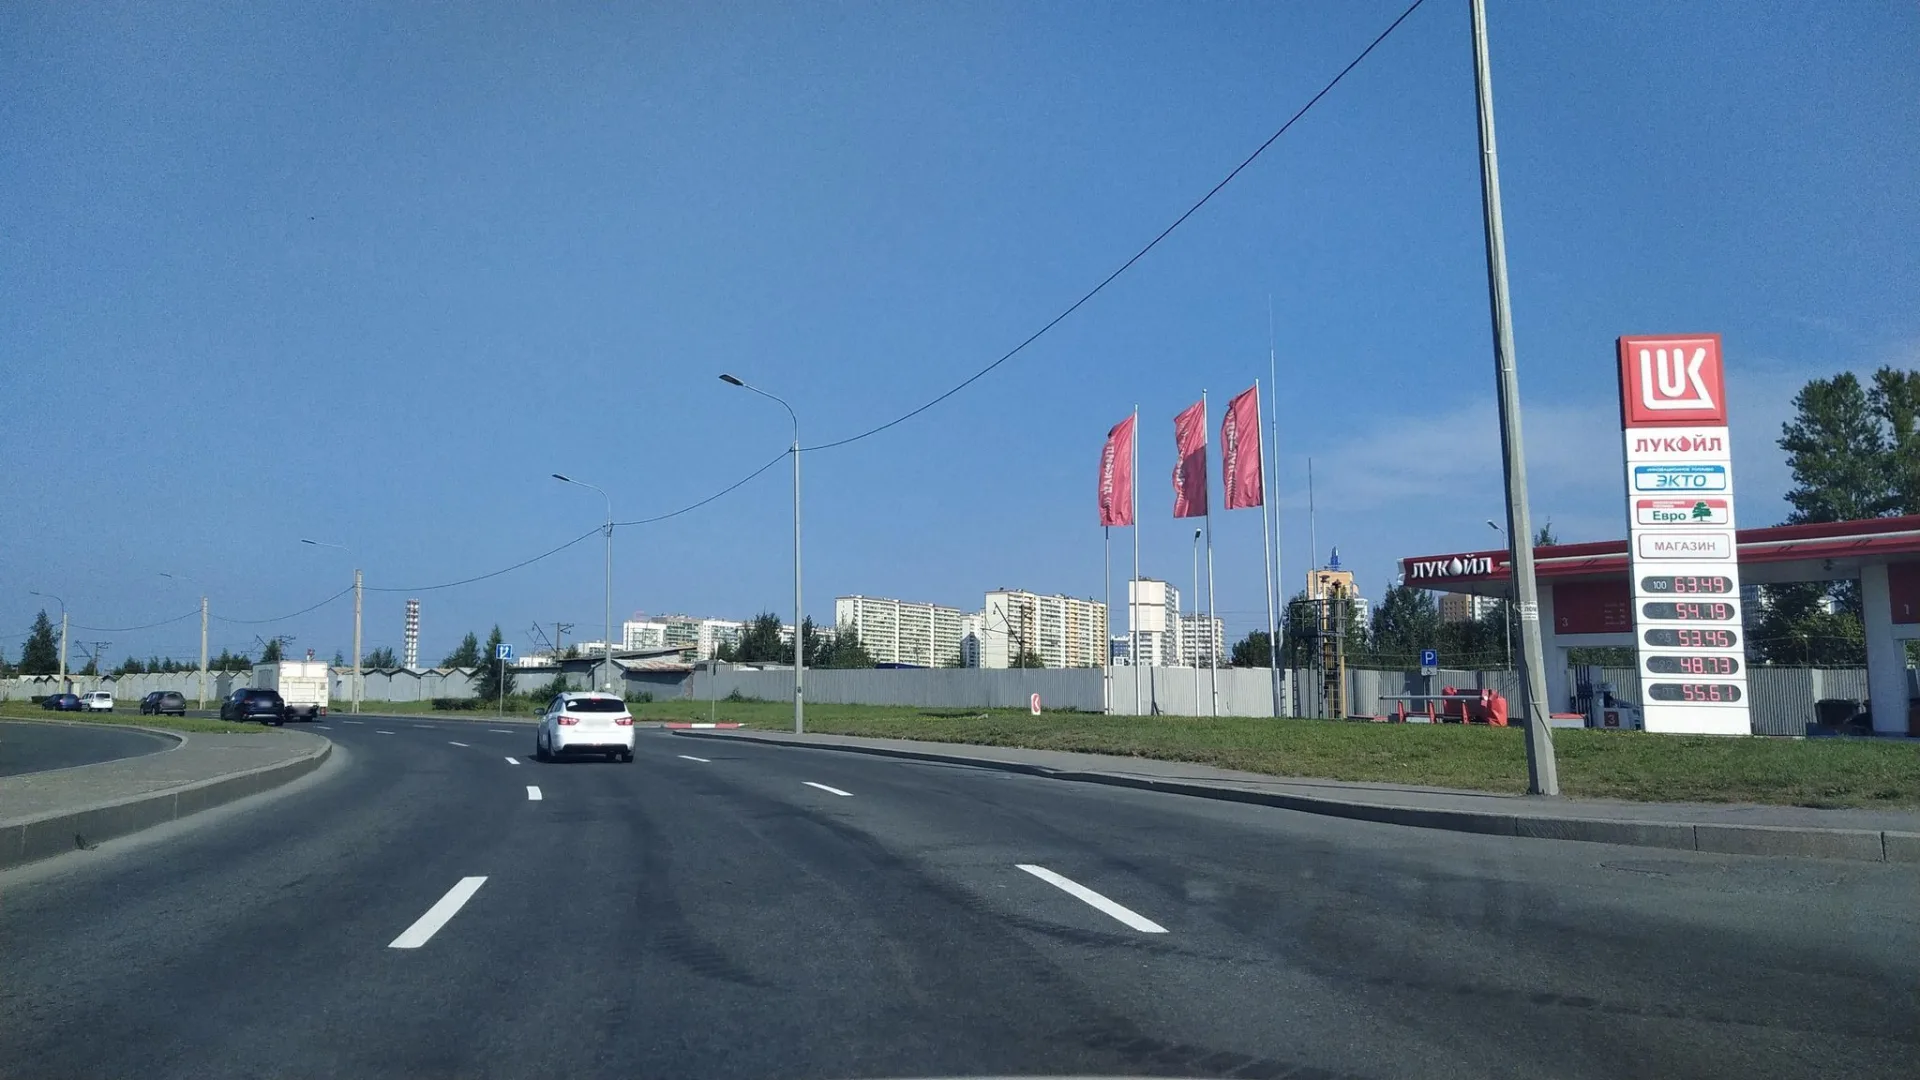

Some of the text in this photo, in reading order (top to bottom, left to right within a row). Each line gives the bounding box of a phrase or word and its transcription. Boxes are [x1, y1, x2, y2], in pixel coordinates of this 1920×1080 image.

[1635, 434, 1722, 453] ЛУКОЙЛ
[1656, 475, 1707, 487] ЭКТО
[1653, 510, 1687, 522] Евро
[1655, 541, 1716, 551] МАГАЗИН
[1411, 554, 1492, 579] ЛУКОЙЛ
[1653, 576, 1724, 593] 100 63.49
[1676, 603, 1726, 620] 54.19
[1678, 630, 1729, 647] 53.45
[1425, 651, 1435, 665] P
[1680, 657, 1731, 674] 48.73
[1682, 684, 1733, 701] 55.61
[1607, 714, 1616, 725] 3
